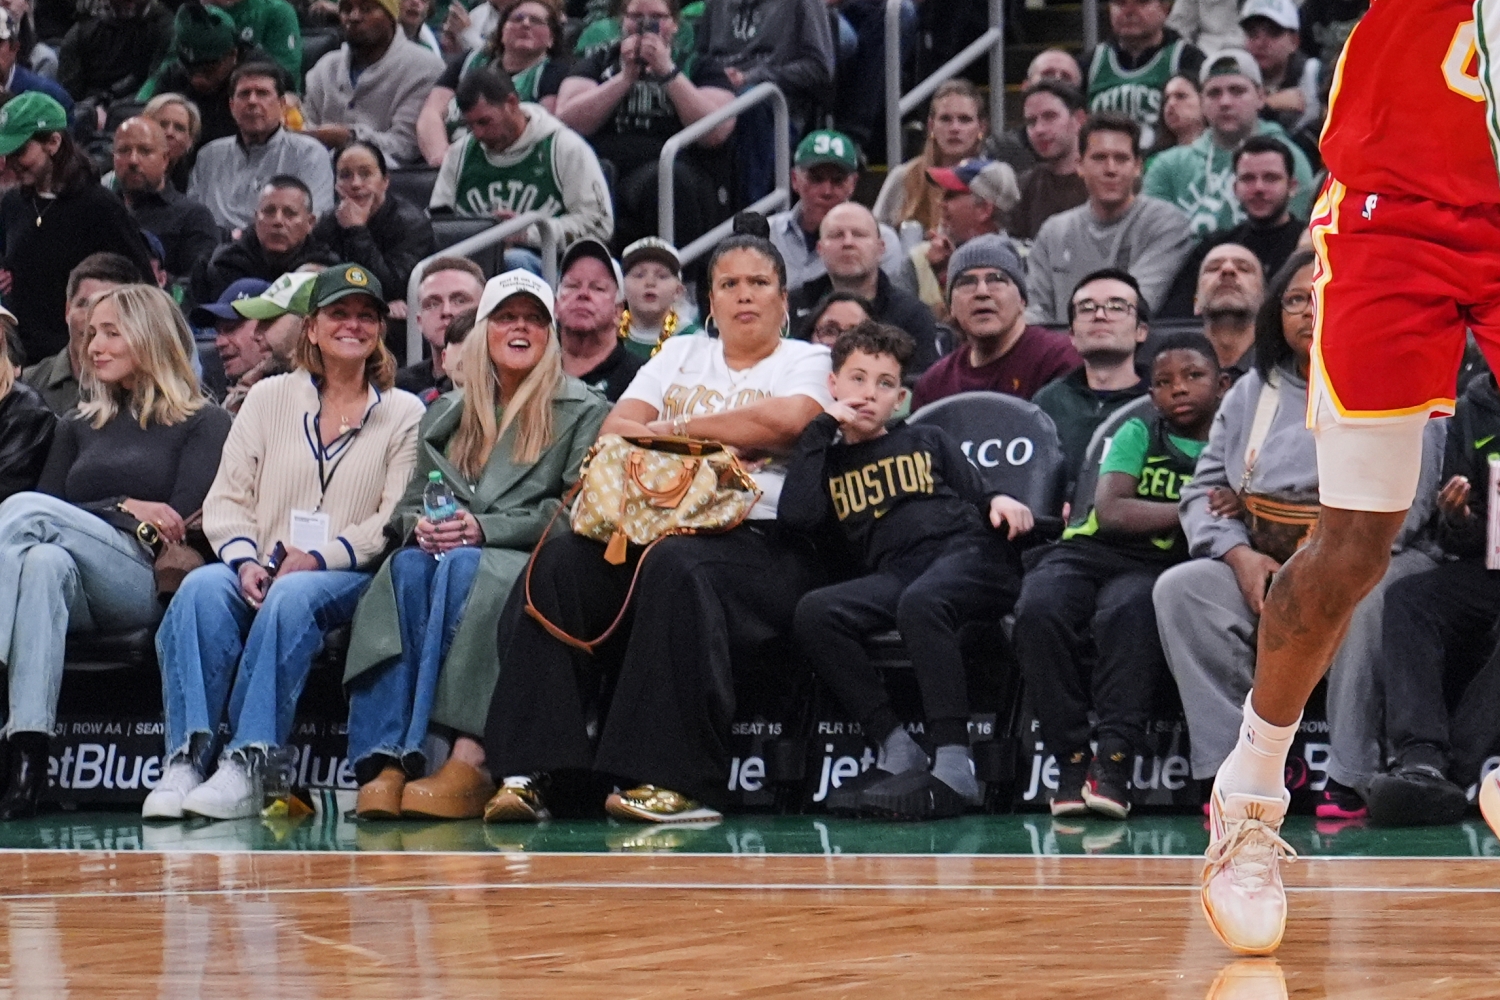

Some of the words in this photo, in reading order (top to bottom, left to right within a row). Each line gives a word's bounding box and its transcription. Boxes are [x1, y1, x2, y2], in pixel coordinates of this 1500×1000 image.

[813, 133, 845, 157] 34
[456, 180, 562, 219] OSTON
[829, 450, 935, 522] BOSTON
[1137, 465, 1193, 500] CELT
[72, 722, 102, 735] ROW
[104, 722, 122, 735] AA
[135, 722, 164, 735] SEAT
[732, 722, 764, 735] SEAT
[768, 722, 782, 735] 15
[818, 722, 844, 735] FLR
[976, 722, 992, 735] 16
[1156, 720, 1183, 733] SEA
[47, 743, 164, 790] etBlue
